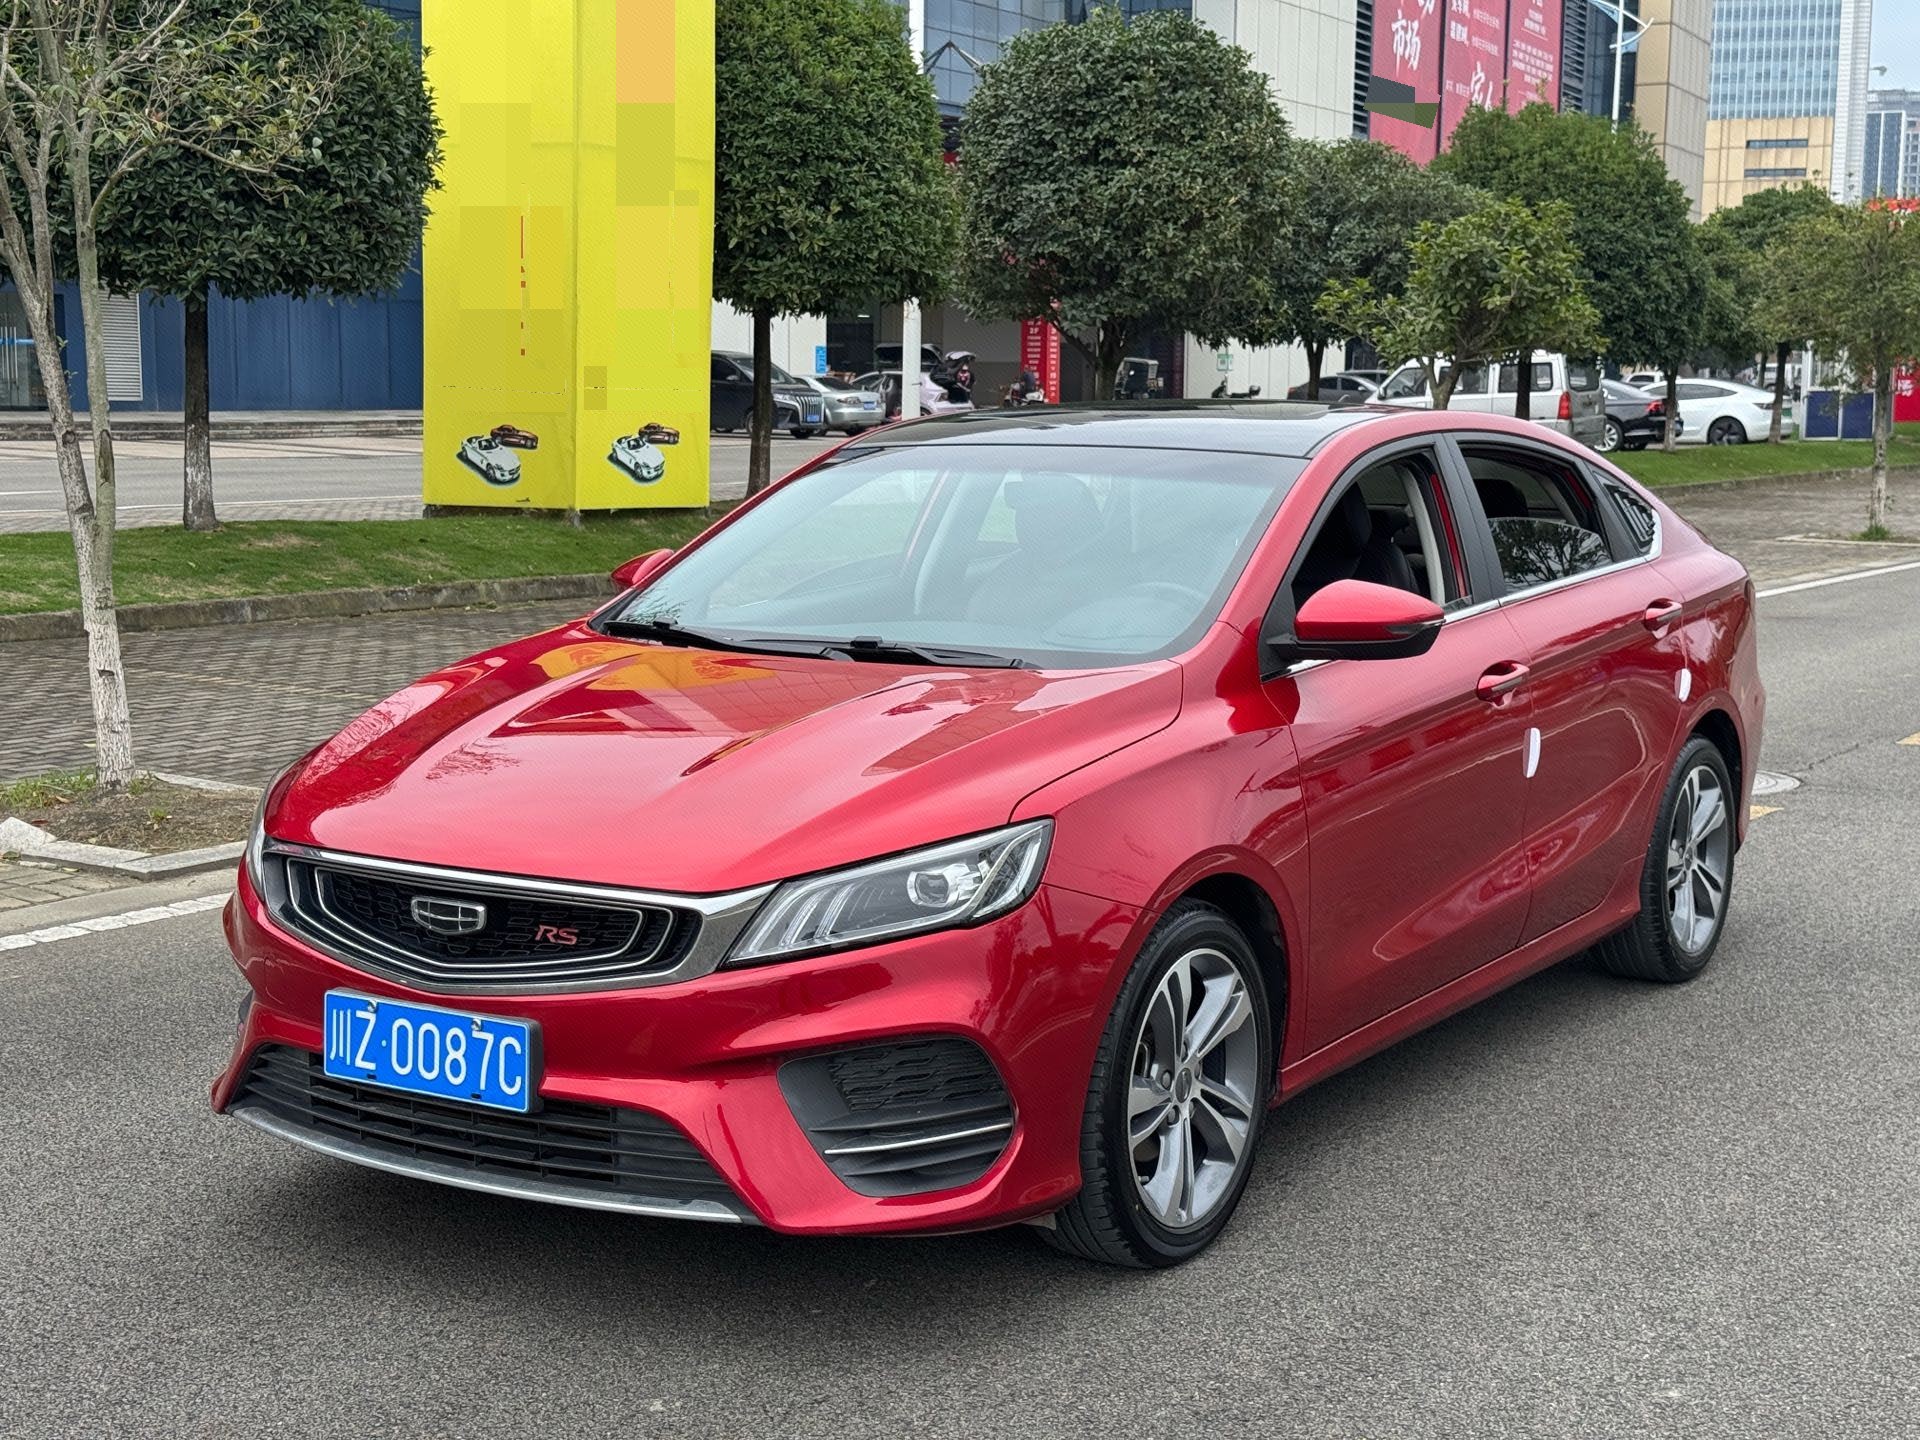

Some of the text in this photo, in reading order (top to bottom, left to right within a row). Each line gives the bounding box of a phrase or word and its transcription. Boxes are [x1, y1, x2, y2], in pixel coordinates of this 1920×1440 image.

[1391, 9, 1421, 77] 市场
[535, 924, 579, 945] RS
[329, 1008, 522, 1096] 川Z·0087C
